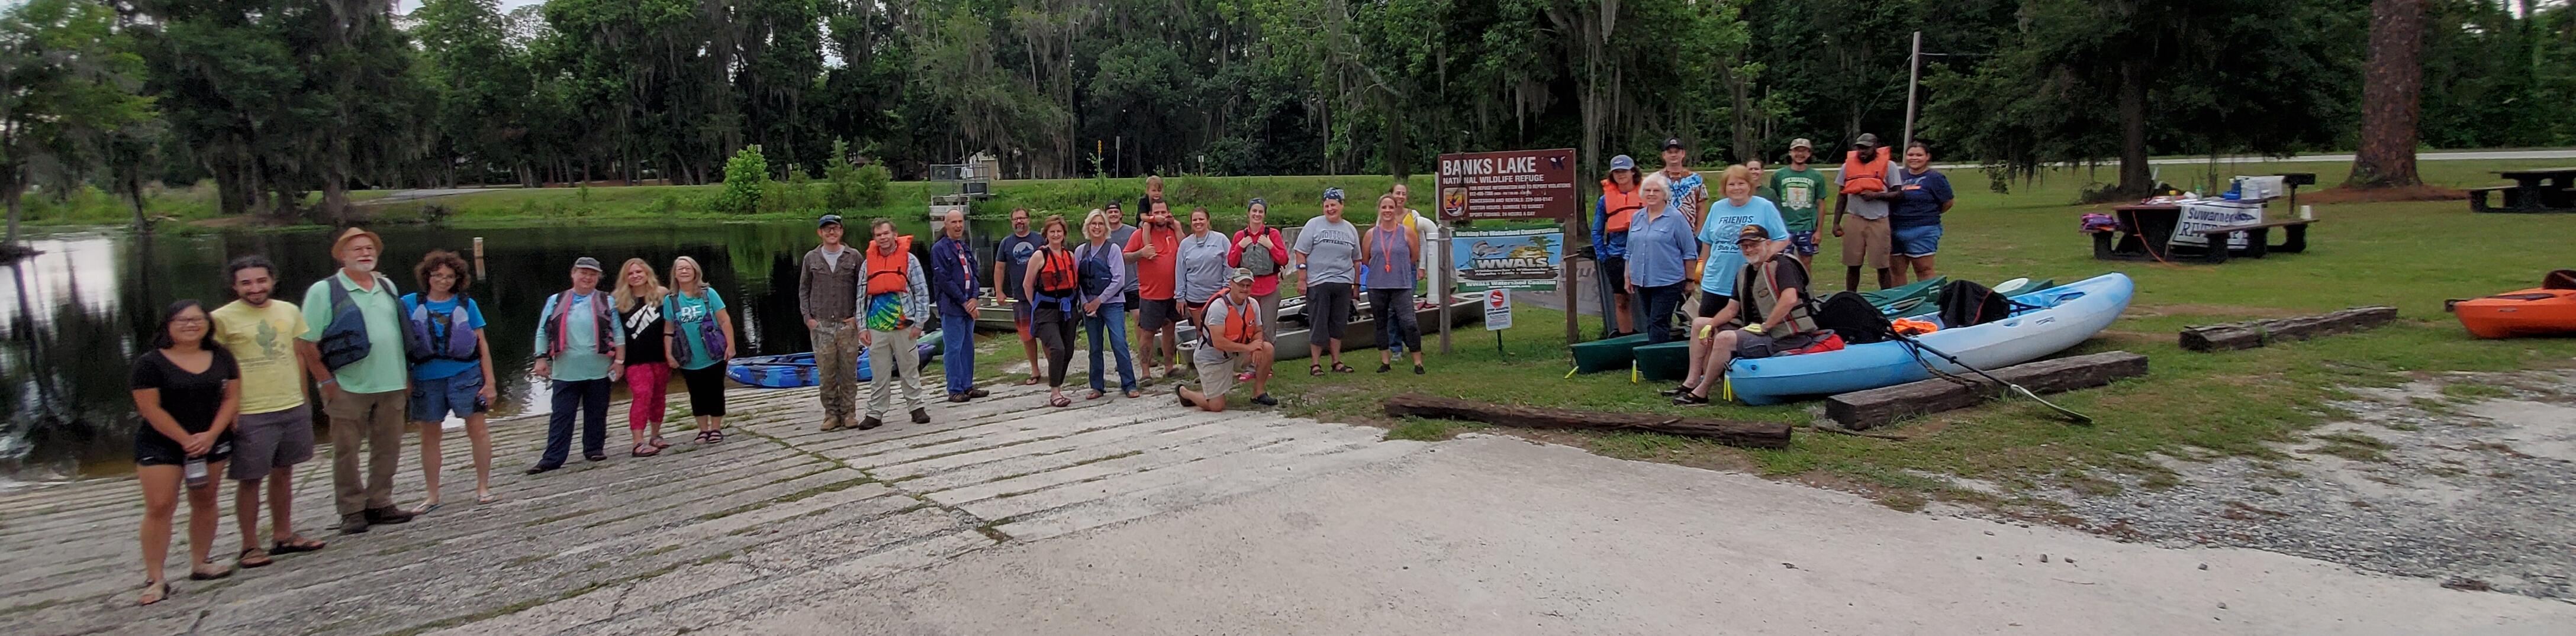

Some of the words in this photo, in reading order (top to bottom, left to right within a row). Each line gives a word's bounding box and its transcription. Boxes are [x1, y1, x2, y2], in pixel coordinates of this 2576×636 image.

[1442, 158, 1493, 175] BANKS
[1498, 156, 1536, 174] LAKE
[1442, 176, 1477, 185] NATINAL
[1479, 175, 1513, 183] WILDLIFE
[1515, 174, 1544, 182] REFUGE
[1719, 215, 1754, 224] FRIENDS
[1477, 257, 1548, 269] WWALS
